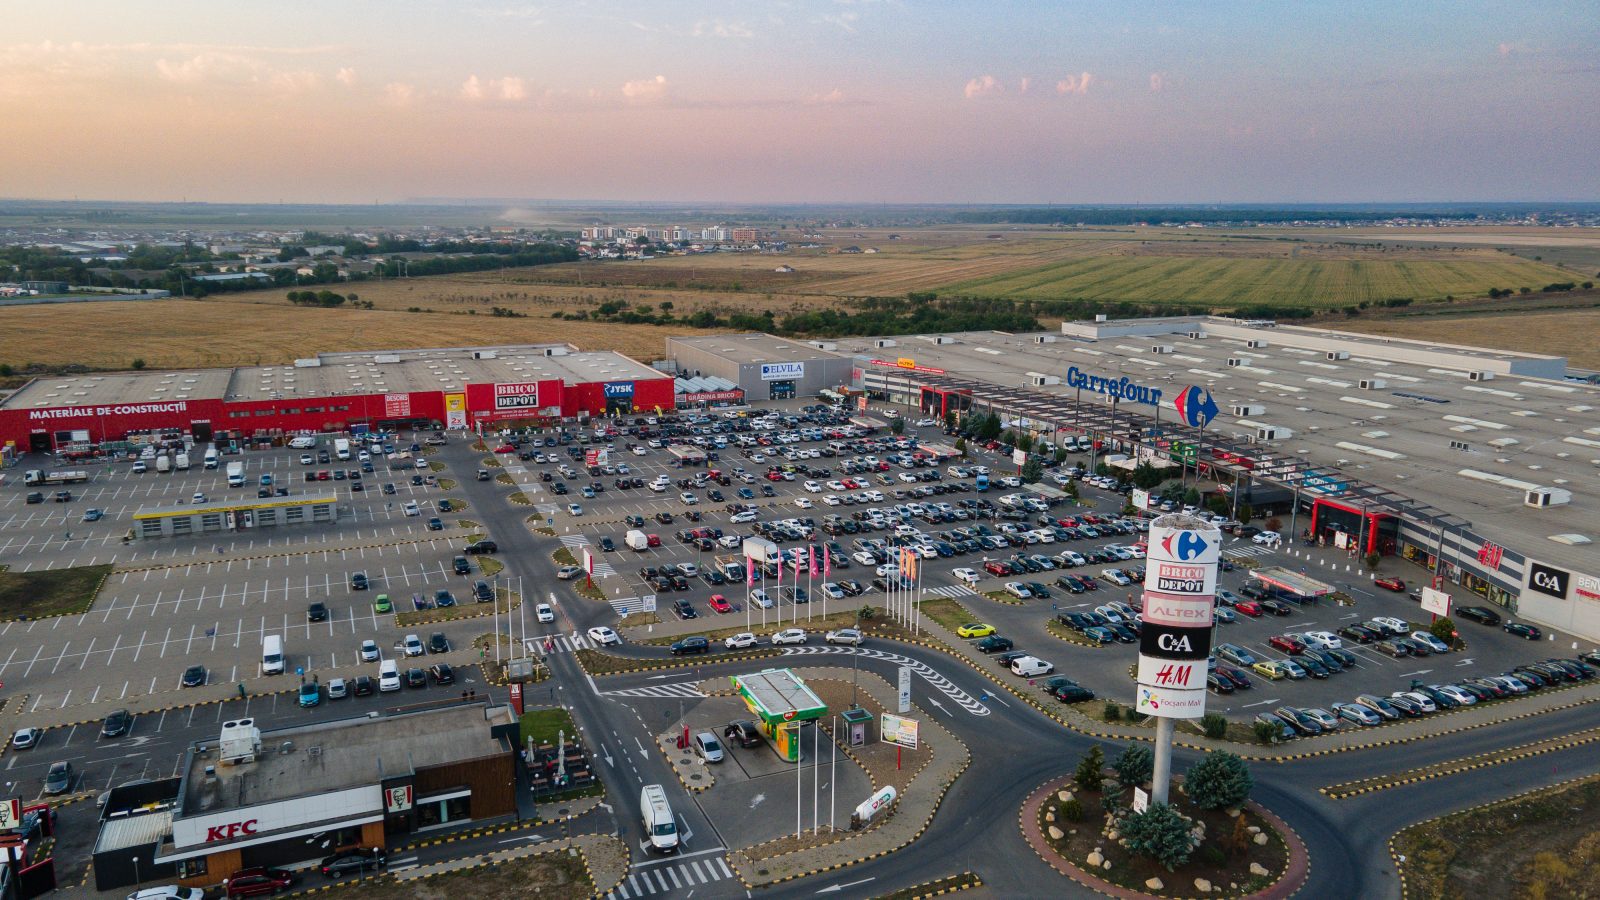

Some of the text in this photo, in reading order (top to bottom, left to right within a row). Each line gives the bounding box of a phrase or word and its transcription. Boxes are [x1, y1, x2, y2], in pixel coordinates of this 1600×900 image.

[771, 364, 802, 373] ELVILA
[497, 384, 535, 395] BRICO
[609, 385, 632, 393] JYSK
[1067, 366, 1162, 406] Carrefour
[97, 407, 112, 416] DE
[1161, 566, 1204, 578] BRICO
[1534, 571, 1561, 592] C&A
[1157, 633, 1193, 652] C&A
[1155, 664, 1193, 687] H&M
[205, 819, 258, 842] KFC
